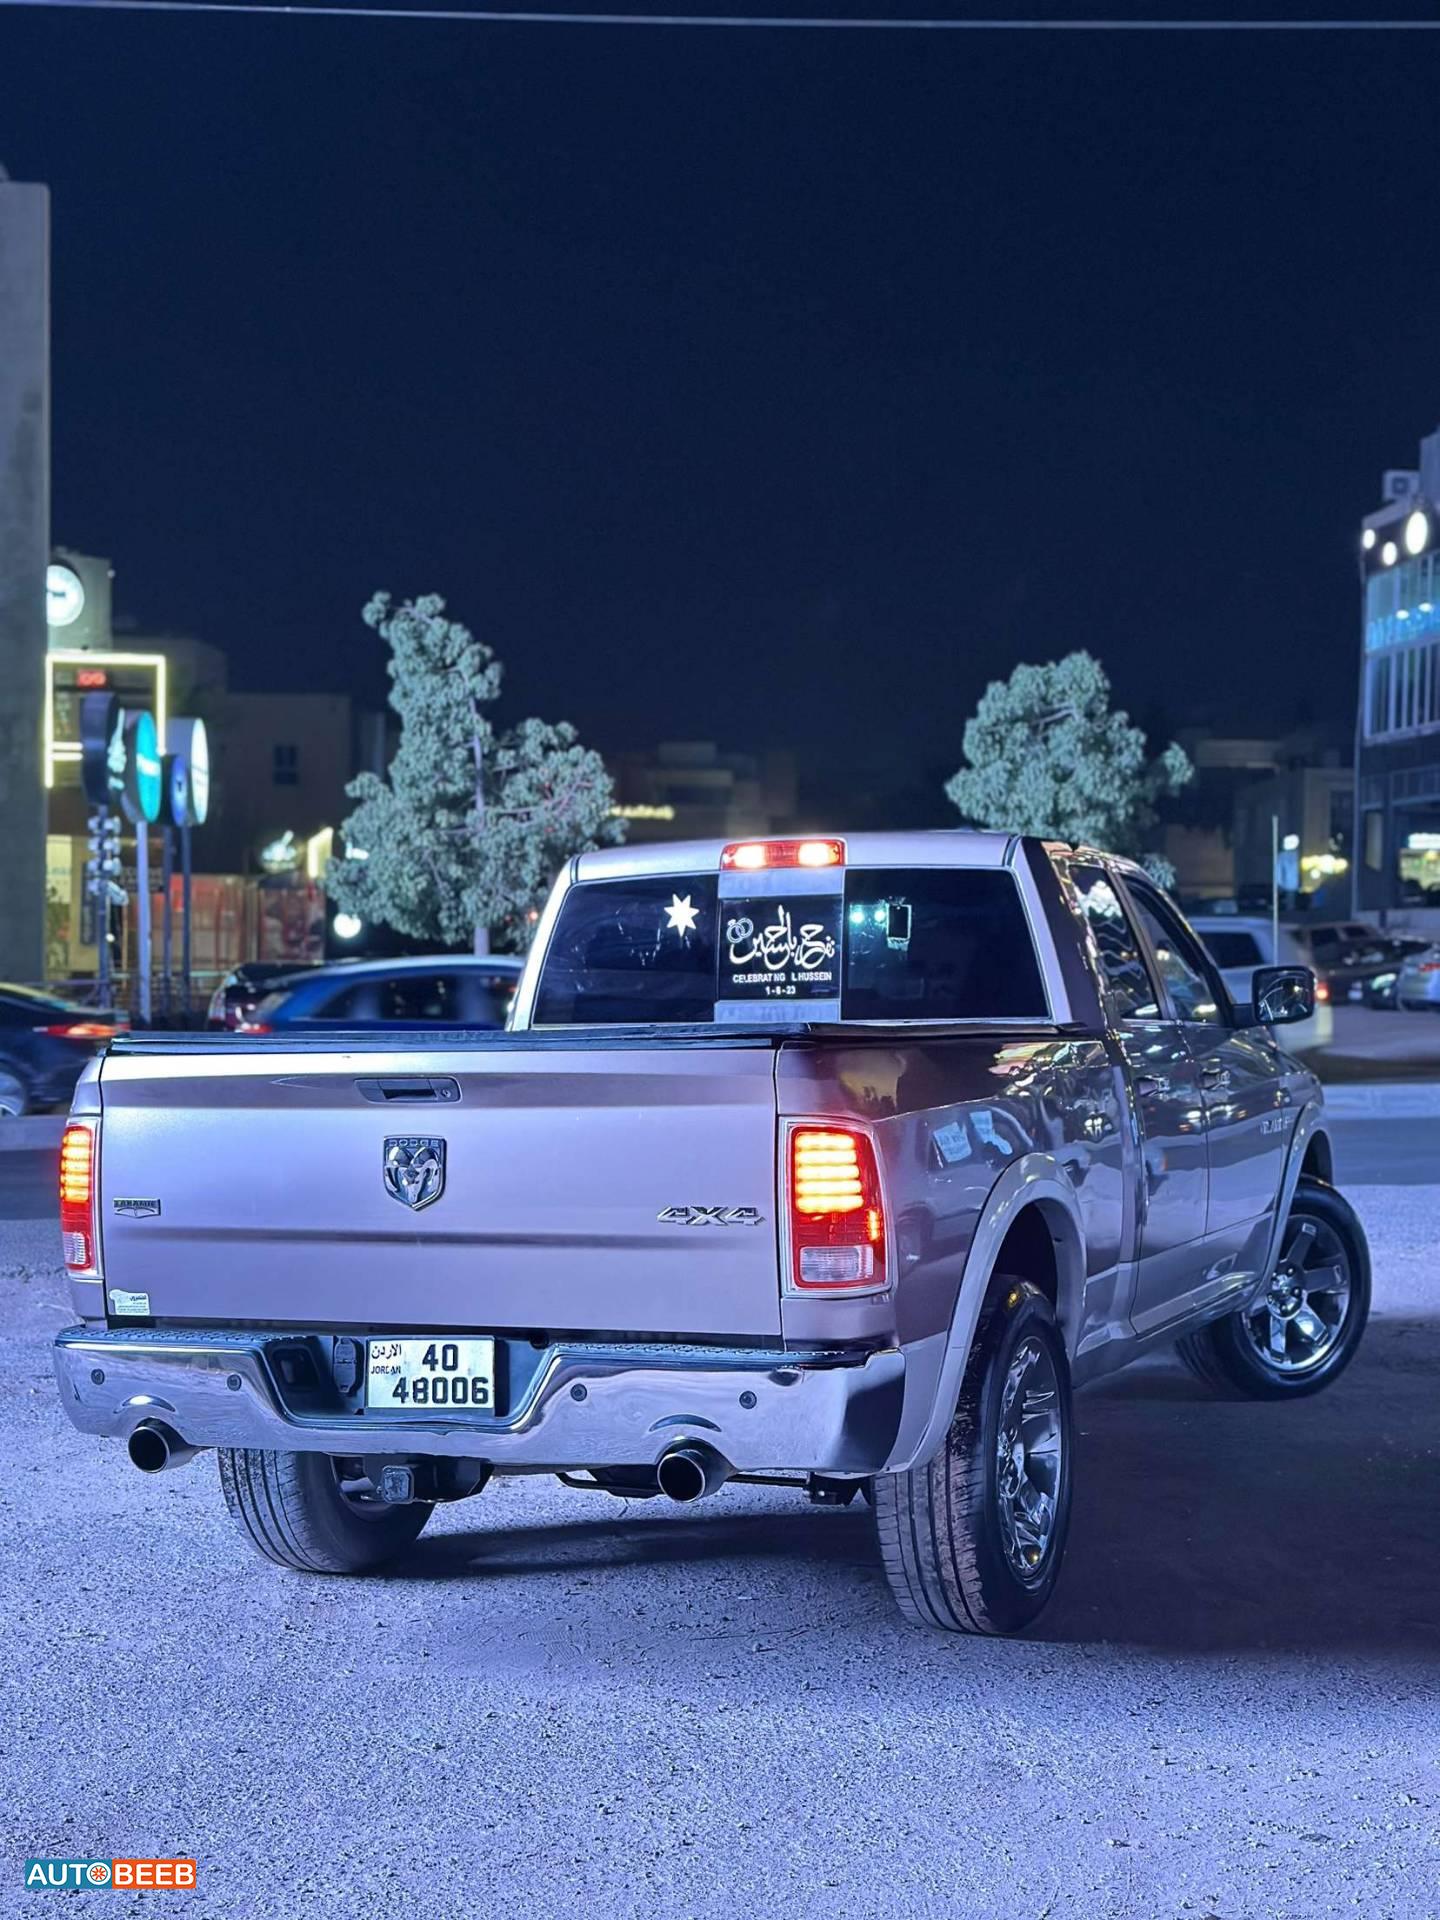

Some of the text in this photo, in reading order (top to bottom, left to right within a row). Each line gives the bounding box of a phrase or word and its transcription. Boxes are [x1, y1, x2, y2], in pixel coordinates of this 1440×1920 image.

[732, 973, 786, 984] CELEBRATNG
[388, 1139, 440, 1148] DODGE
[422, 1344, 459, 1371] 40
[370, 1365, 402, 1375] JORDAN
[392, 1377, 489, 1404] 48006
